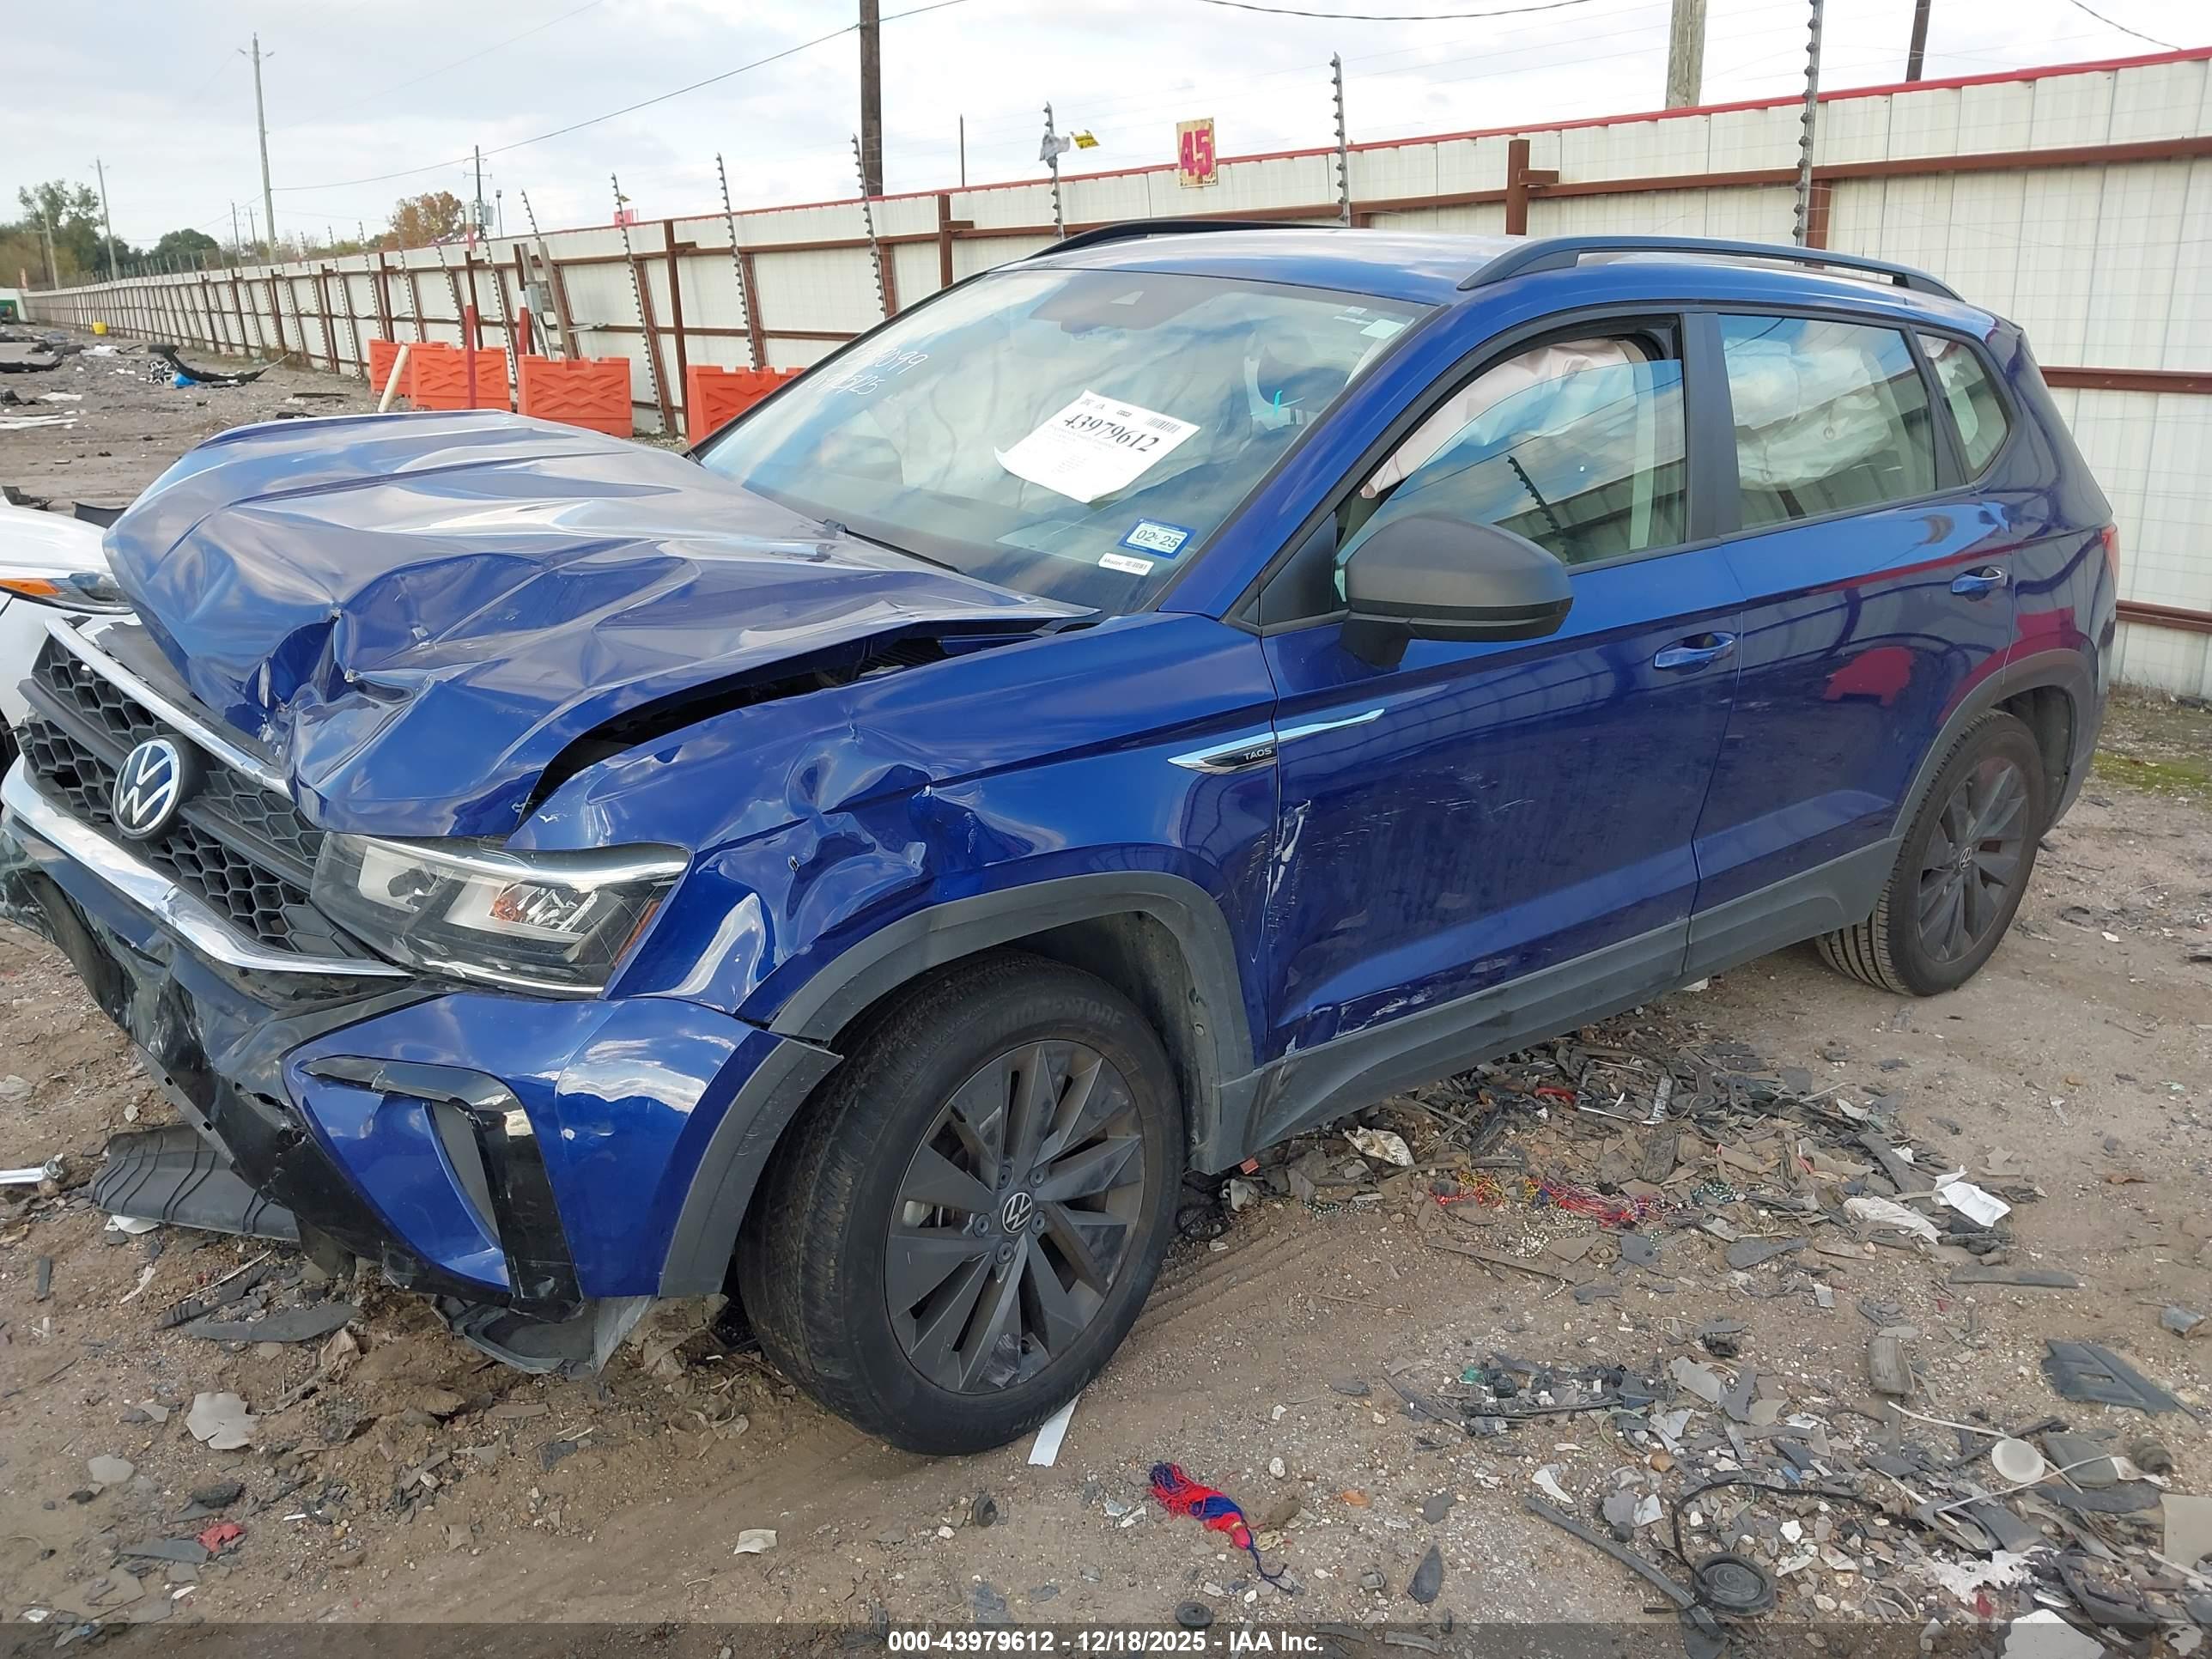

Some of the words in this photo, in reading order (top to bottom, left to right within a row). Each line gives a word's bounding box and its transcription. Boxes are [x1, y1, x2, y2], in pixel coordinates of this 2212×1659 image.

[1180, 130, 1212, 176] 45
[1064, 413, 1160, 452] 43979612
[1136, 529, 1156, 542] 02
[1158, 535, 1181, 548] 25
[1243, 747, 1273, 761] TAOS
